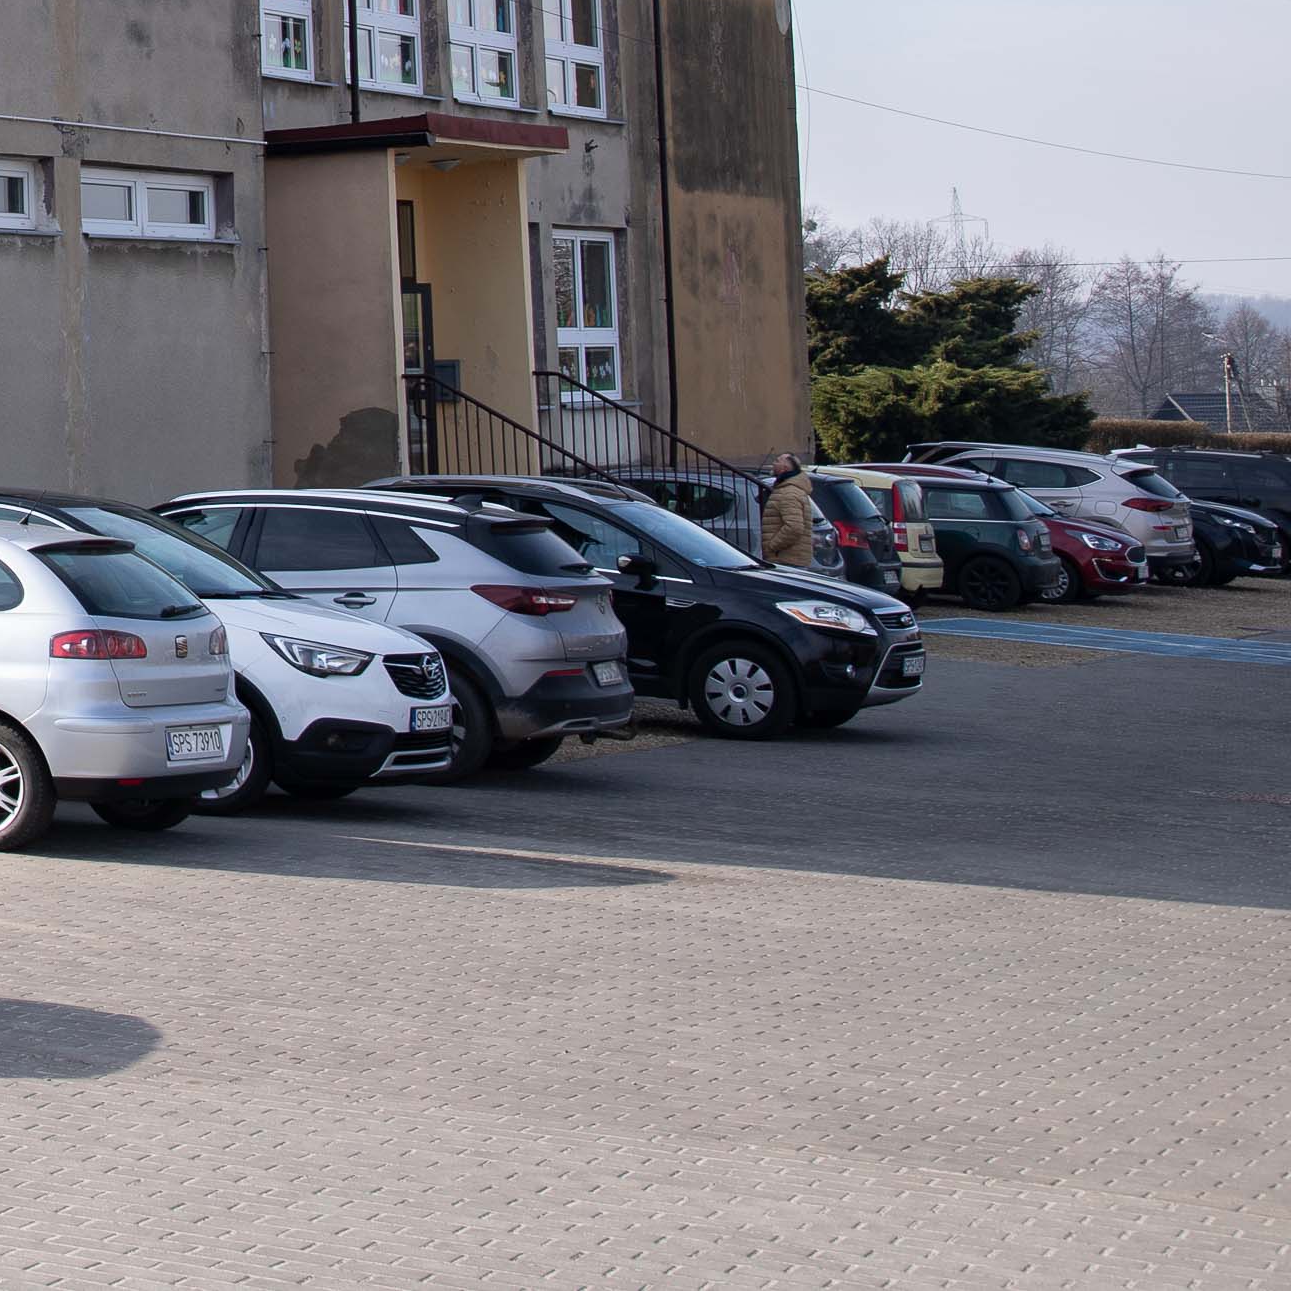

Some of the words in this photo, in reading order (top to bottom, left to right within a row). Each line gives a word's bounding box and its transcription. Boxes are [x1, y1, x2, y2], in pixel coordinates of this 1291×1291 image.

[417, 710, 432, 728] SPS
[172, 733, 192, 753] SPS
[192, 731, 221, 751] 73910
